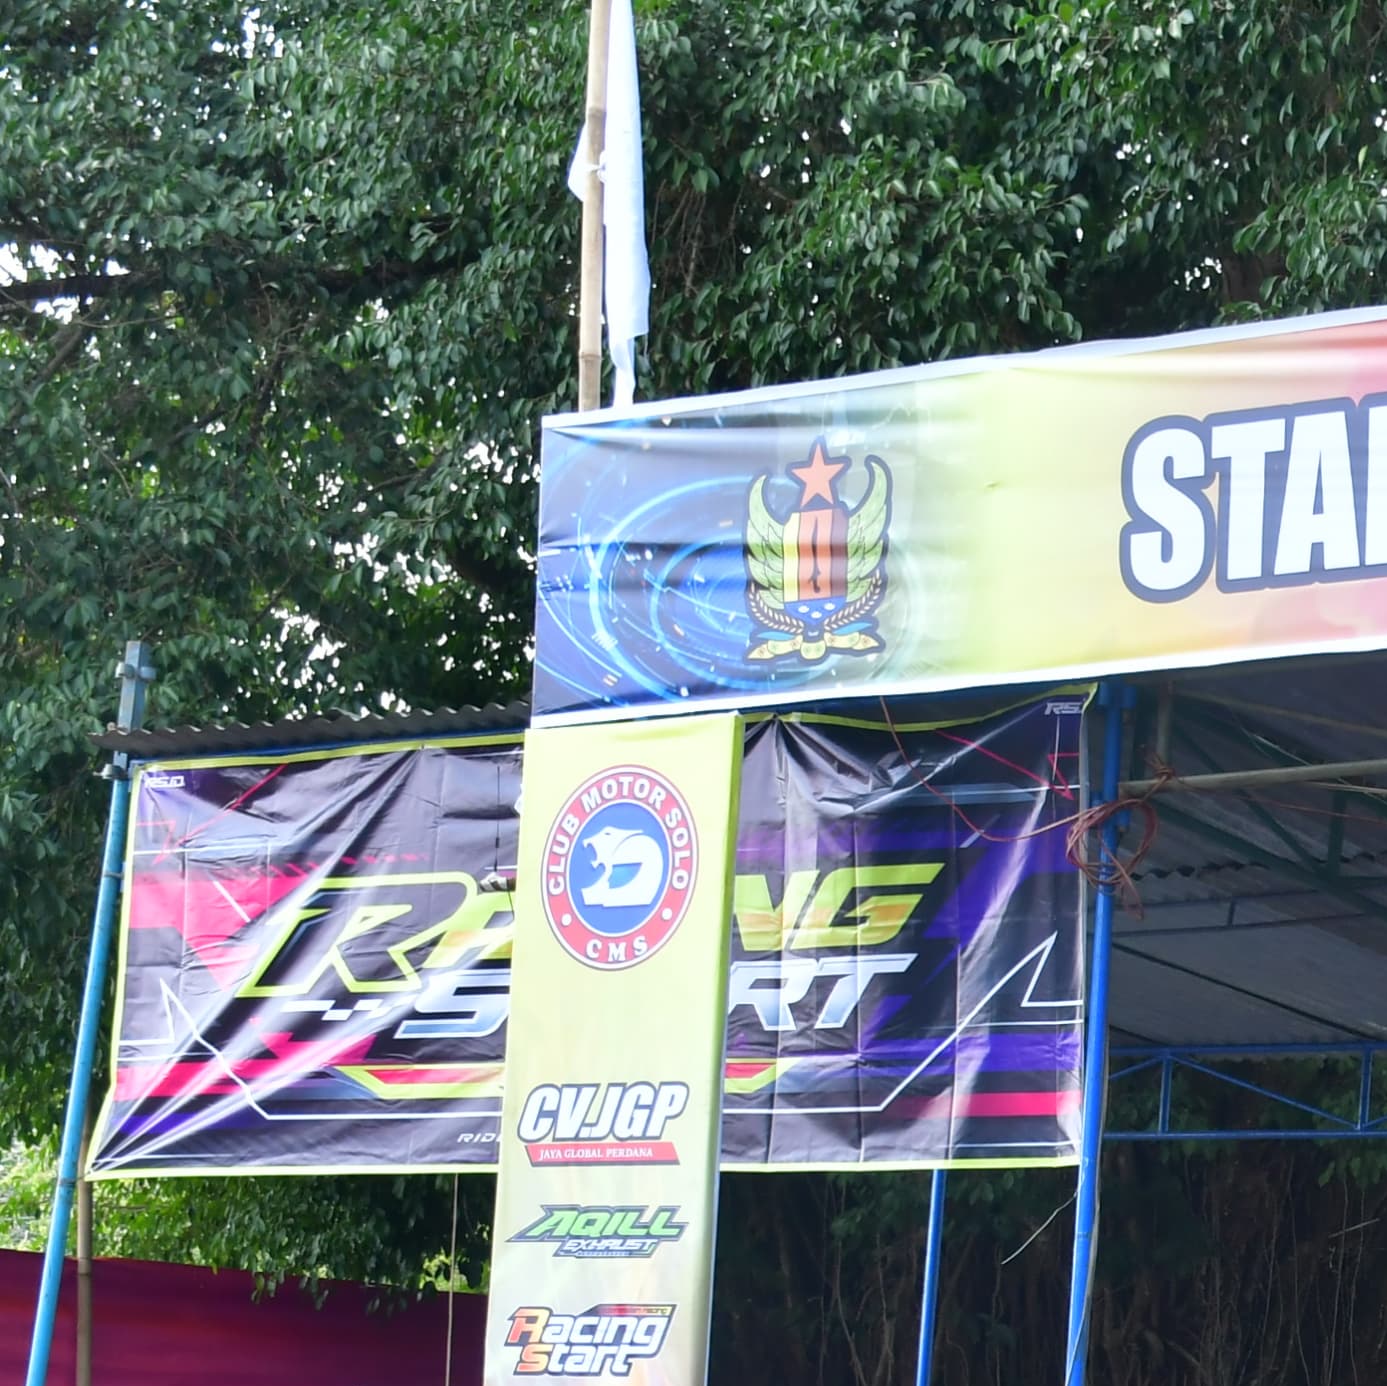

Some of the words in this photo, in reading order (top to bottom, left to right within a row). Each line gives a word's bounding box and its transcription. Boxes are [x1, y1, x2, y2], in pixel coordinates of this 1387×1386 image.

[548, 814, 580, 895] CLUB
[581, 776, 667, 813] MOTOR
[665, 808, 690, 890] SOLO
[586, 936, 648, 962] CMS
[539, 1148, 562, 1160] JAYA
[564, 1148, 603, 1158] GLOBAL
[606, 1147, 653, 1158] PERDANA
[518, 1205, 685, 1239] AQILL
[505, 1306, 674, 1357] Racing
